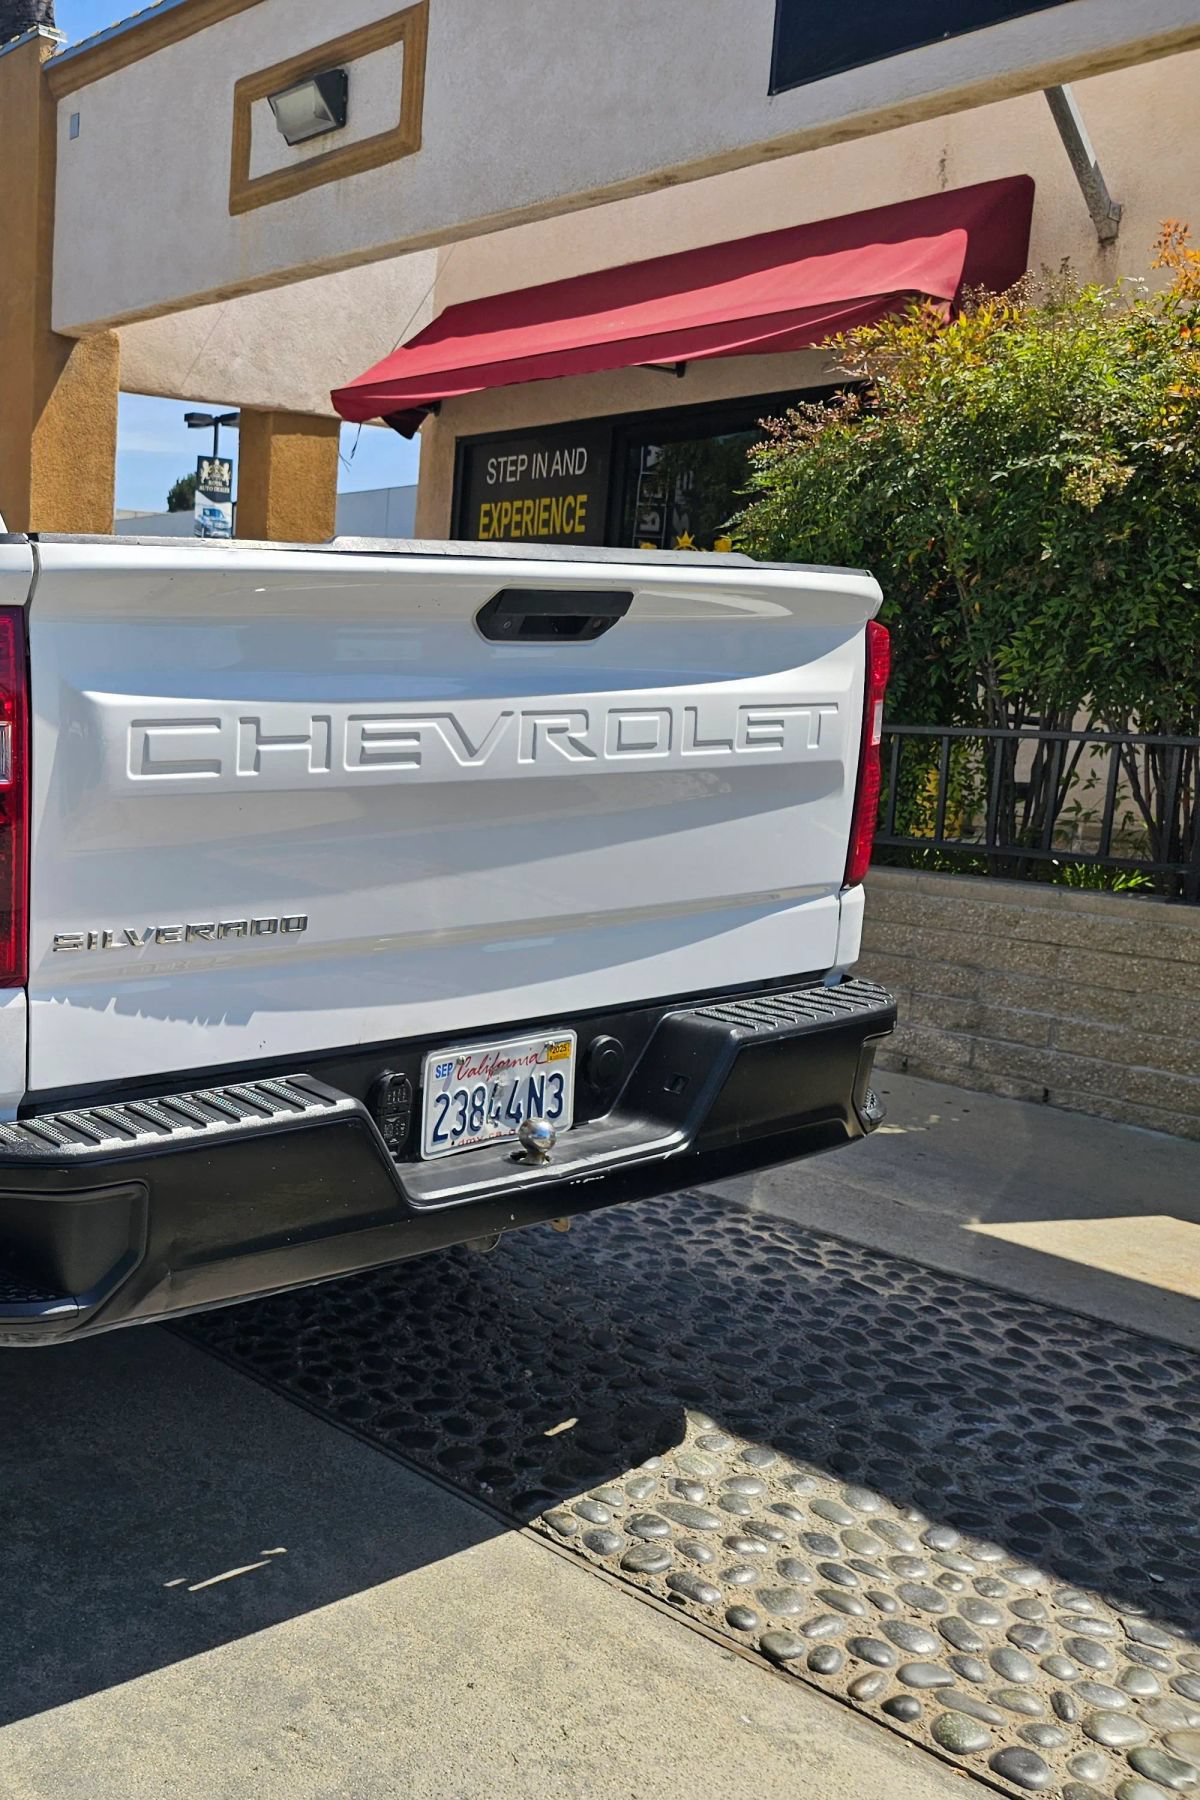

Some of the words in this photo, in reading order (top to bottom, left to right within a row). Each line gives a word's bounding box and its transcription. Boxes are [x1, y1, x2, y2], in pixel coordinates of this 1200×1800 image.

[486, 454, 528, 485] STEP
[531, 451, 549, 480] IN
[550, 447, 588, 478] AND
[478, 494, 588, 540] EXPERIENCE
[126, 702, 839, 780] CHEVROLET
[52, 913, 309, 952] SILVERADO
[435, 1062, 454, 1080] SEP
[457, 1048, 549, 1081] California
[552, 1043, 568, 1055] 2025
[432, 1072, 565, 1143] 23844N3
